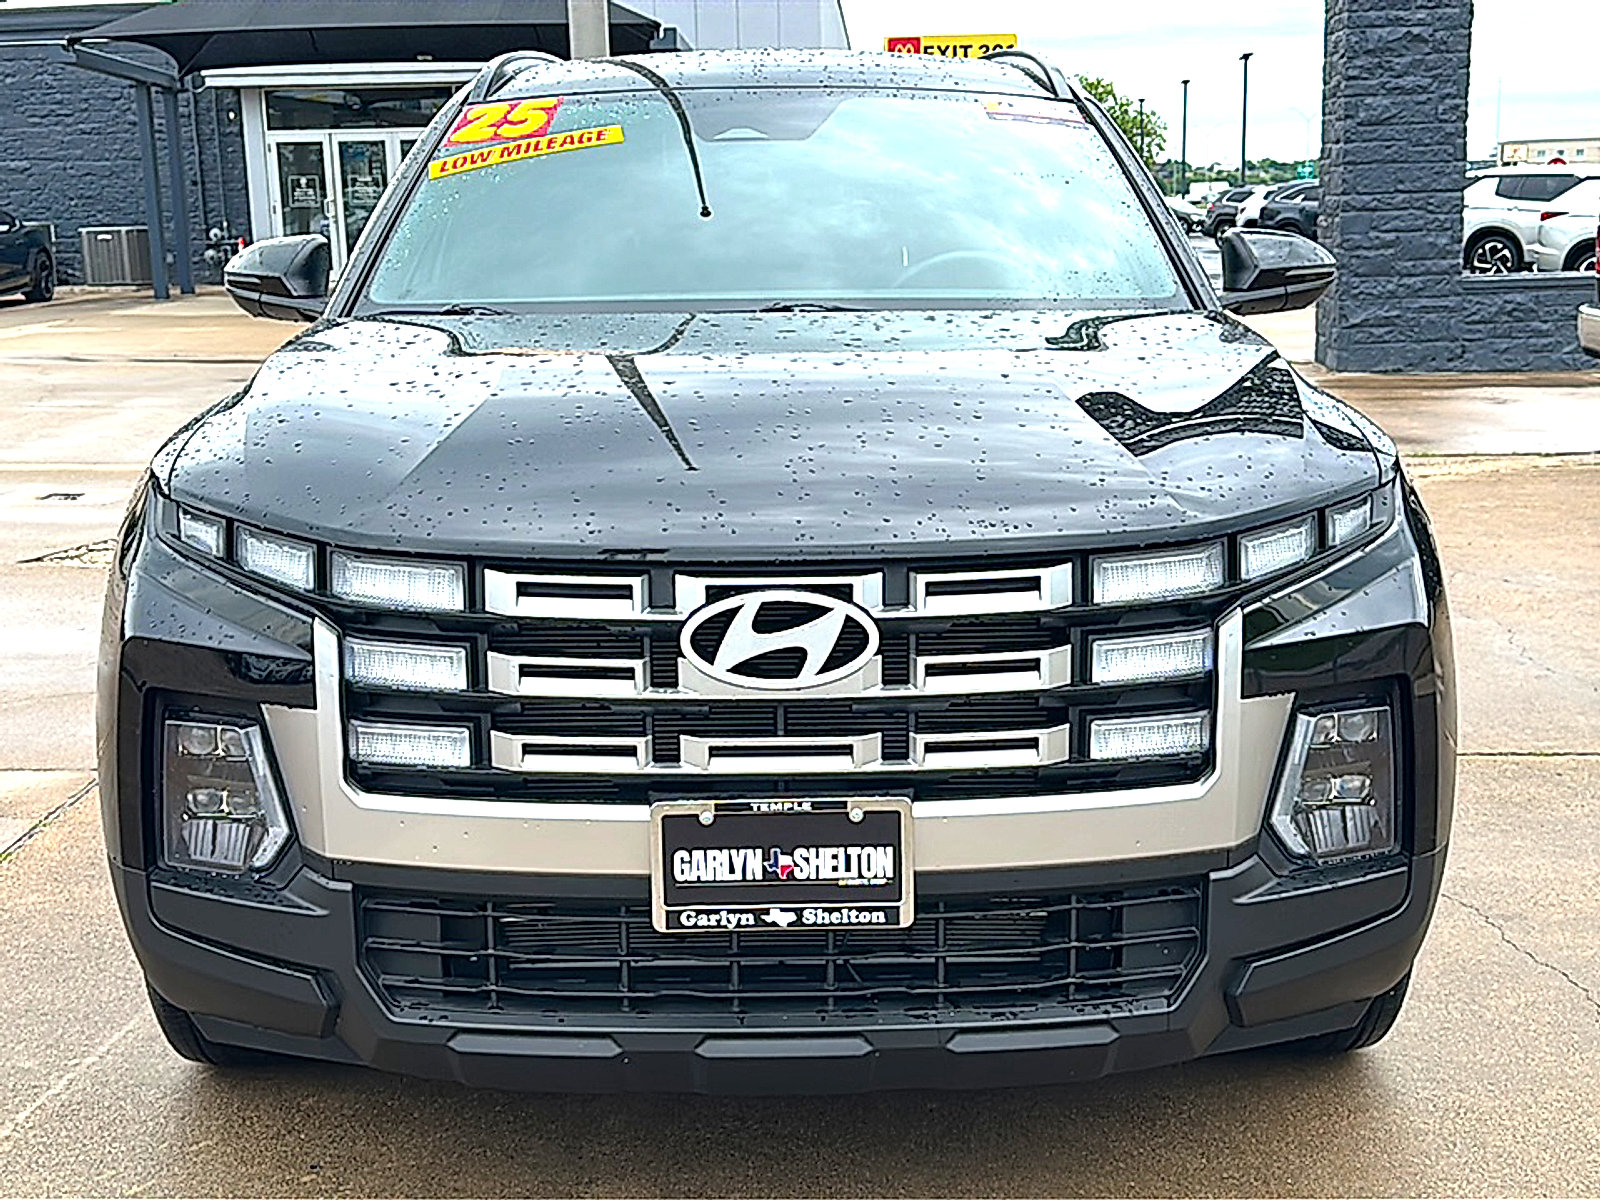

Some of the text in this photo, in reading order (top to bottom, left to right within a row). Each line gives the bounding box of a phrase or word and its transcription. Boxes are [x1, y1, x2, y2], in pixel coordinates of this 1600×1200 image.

[923, 44, 973, 58] EXIT
[449, 98, 559, 142] 25
[440, 128, 611, 173] LOW MILEAGE
[750, 801, 813, 812] TEMPLE
[673, 846, 894, 881] GARLYN SHELTON
[680, 908, 886, 929] Garlyn Shelton
